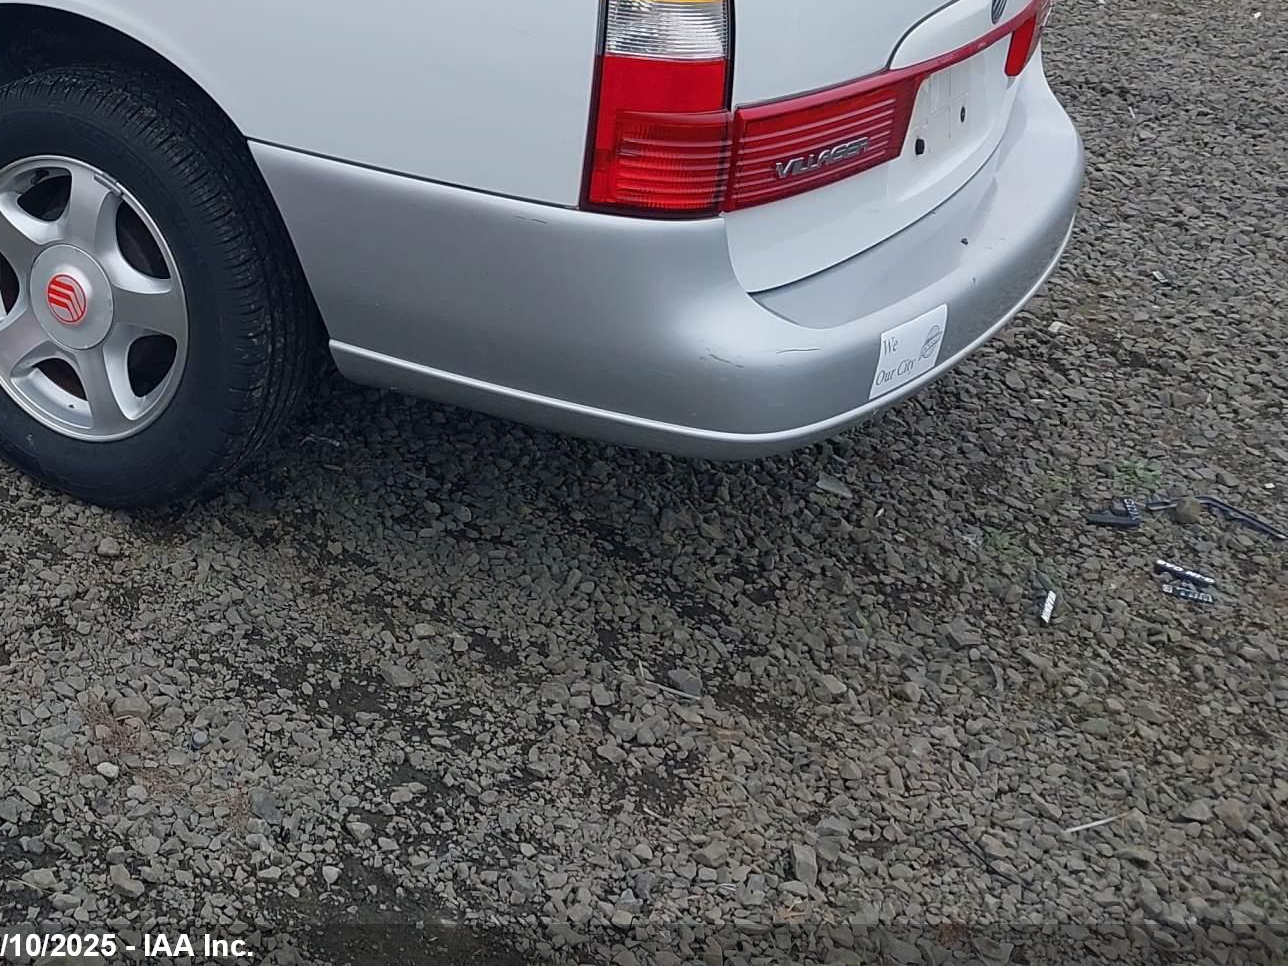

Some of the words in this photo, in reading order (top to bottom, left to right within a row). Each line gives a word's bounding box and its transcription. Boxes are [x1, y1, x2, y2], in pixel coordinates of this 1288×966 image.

[776, 137, 869, 178] VILLAGER
[883, 337, 898, 355] We
[875, 368, 896, 386] Our
[897, 357, 916, 376] City
